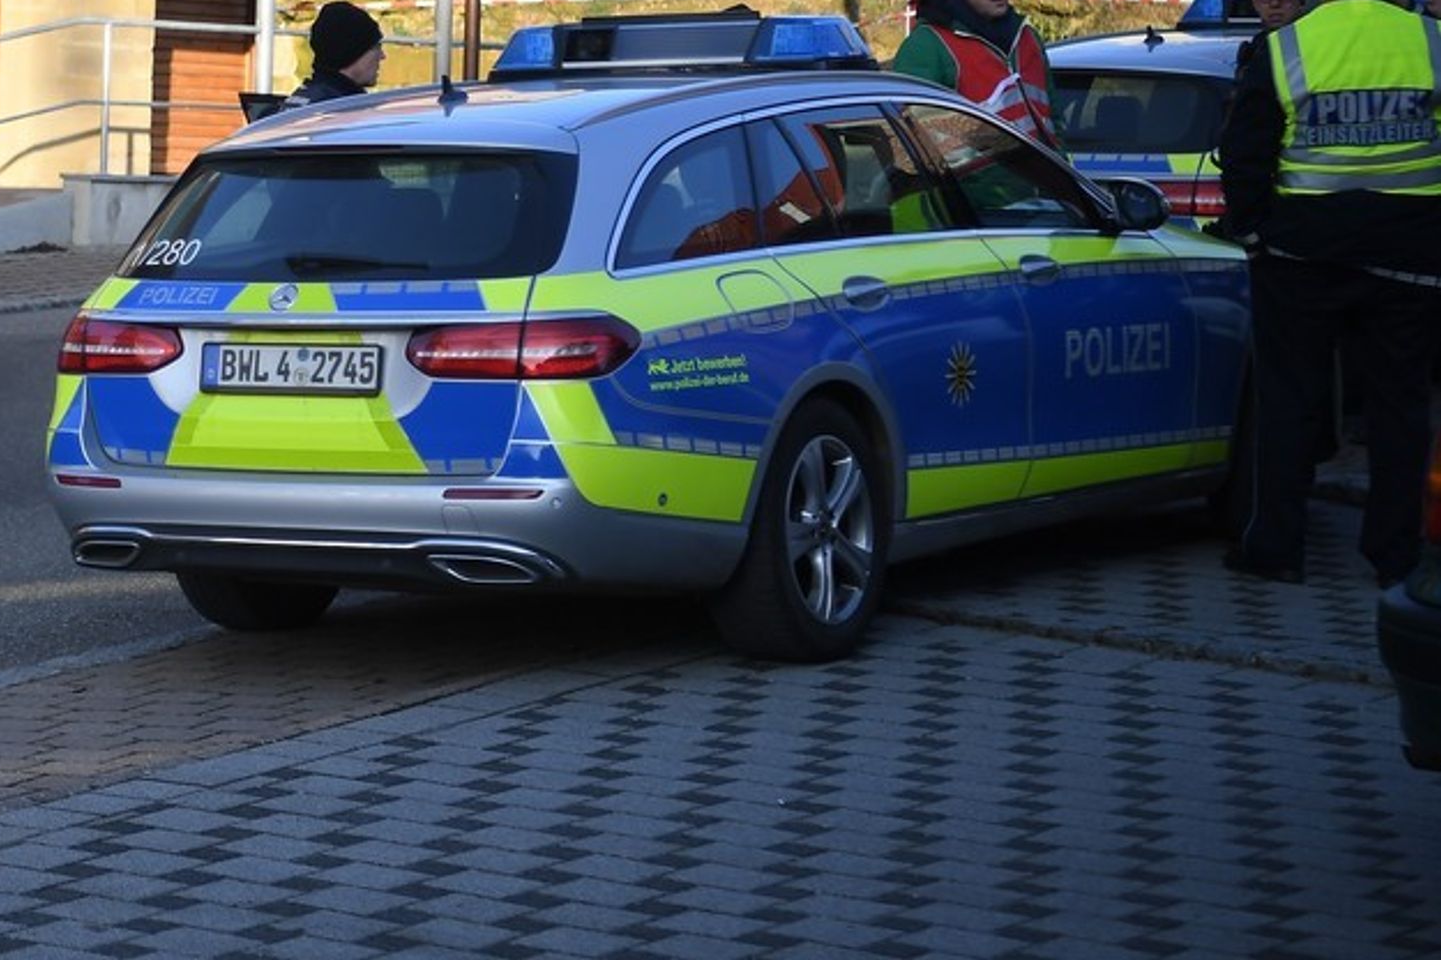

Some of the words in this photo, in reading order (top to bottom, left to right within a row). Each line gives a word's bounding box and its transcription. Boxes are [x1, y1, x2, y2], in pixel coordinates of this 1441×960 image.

[1309, 121, 1434, 146] EINSATZLEITER
[139, 286, 220, 305] POLIZEI
[1065, 321, 1171, 379] POLIZEI
[220, 349, 269, 383] BWL
[276, 350, 291, 383] 4
[311, 351, 376, 385] 2745
